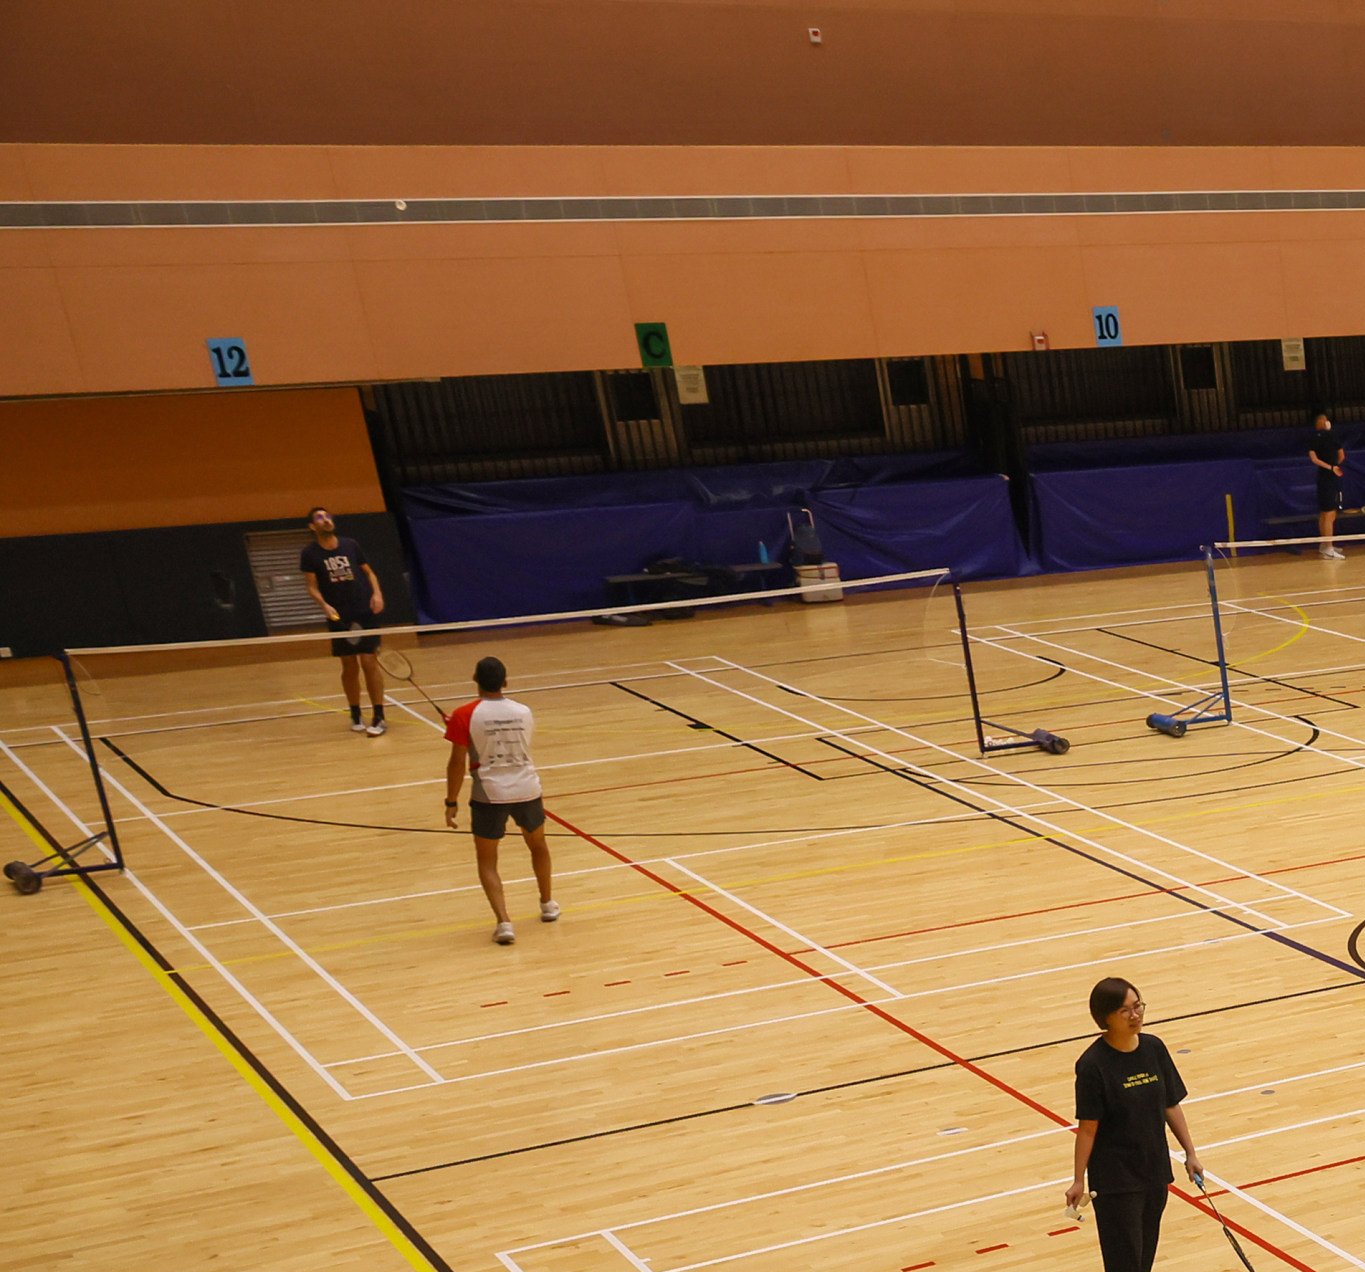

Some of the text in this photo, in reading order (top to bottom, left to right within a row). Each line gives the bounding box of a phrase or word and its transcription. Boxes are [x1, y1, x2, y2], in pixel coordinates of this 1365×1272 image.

[1095, 313, 1119, 340] 10
[642, 331, 667, 359] C
[211, 345, 250, 378] 12
